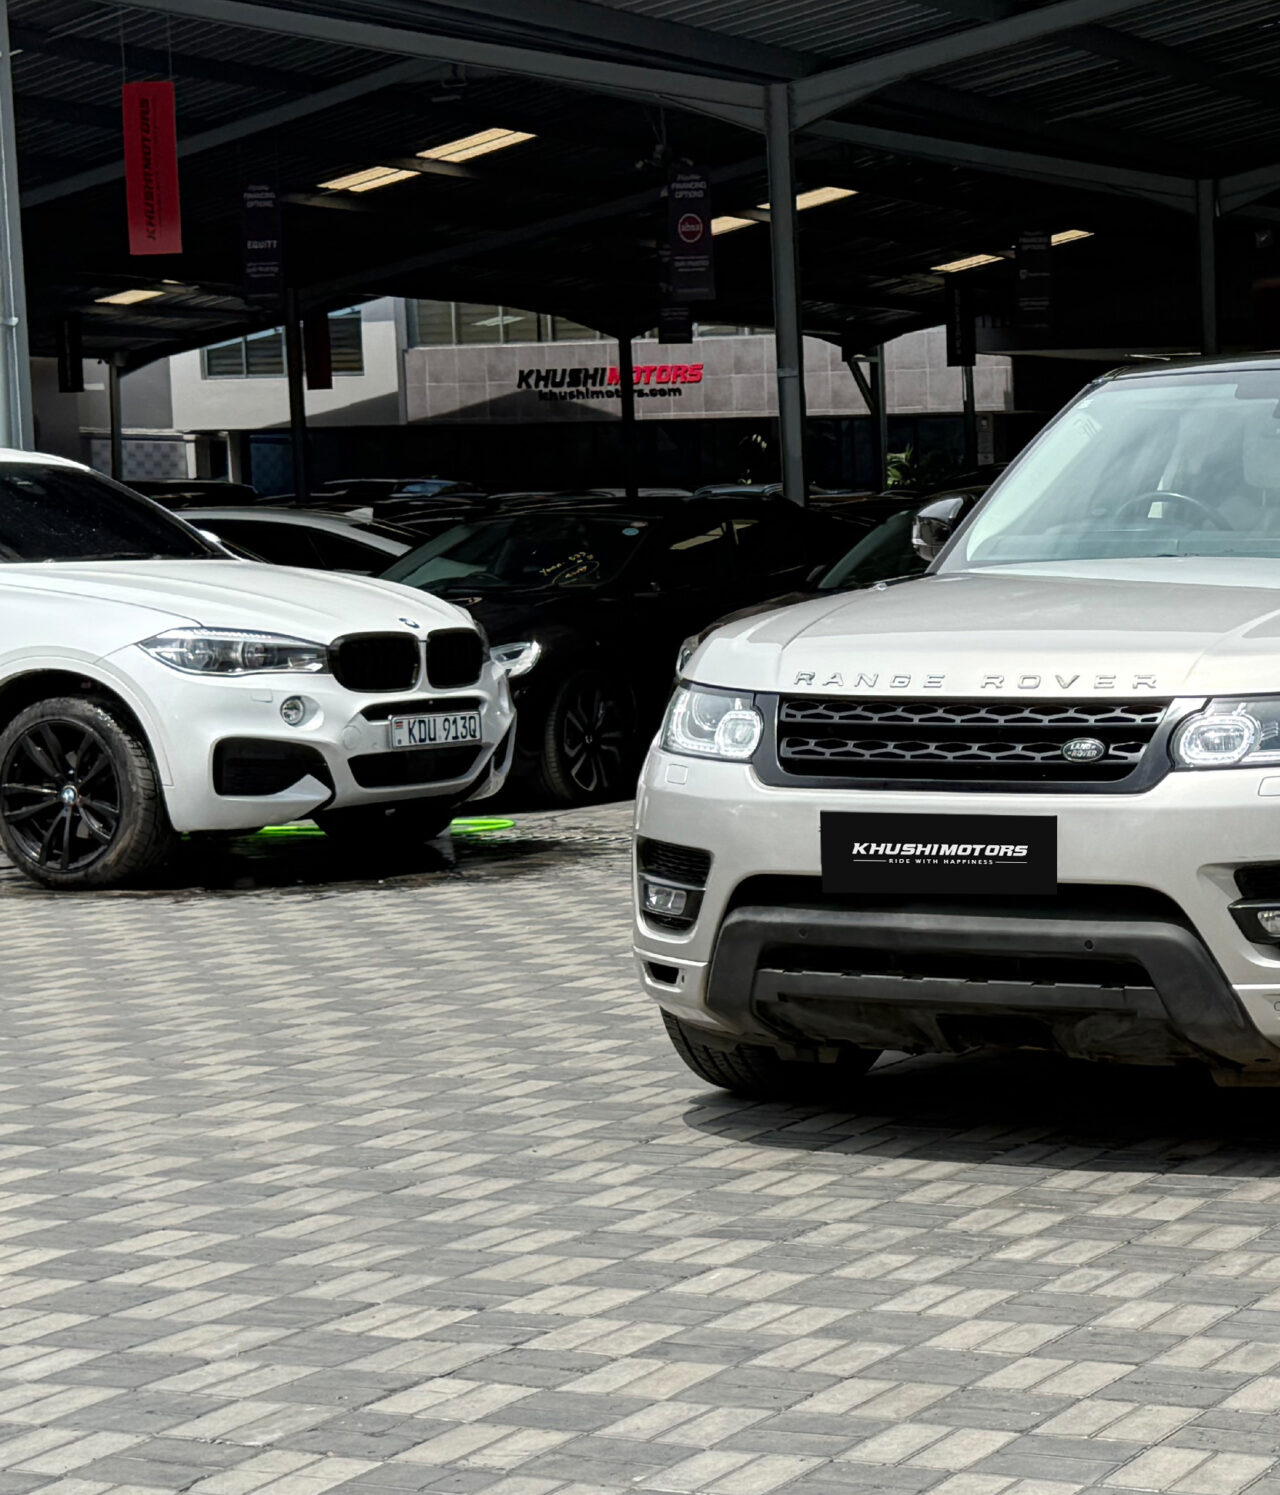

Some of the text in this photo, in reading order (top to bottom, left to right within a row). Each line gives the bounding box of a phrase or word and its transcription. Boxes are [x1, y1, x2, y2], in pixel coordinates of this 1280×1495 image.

[538, 388, 682, 401] khushimotrs.com
[793, 671, 1159, 690] RANGE ROVER
[408, 715, 477, 744] KDU 913Q
[1071, 750, 1098, 758] ROVER
[852, 842, 1029, 857] KHUSHIMOTORS
